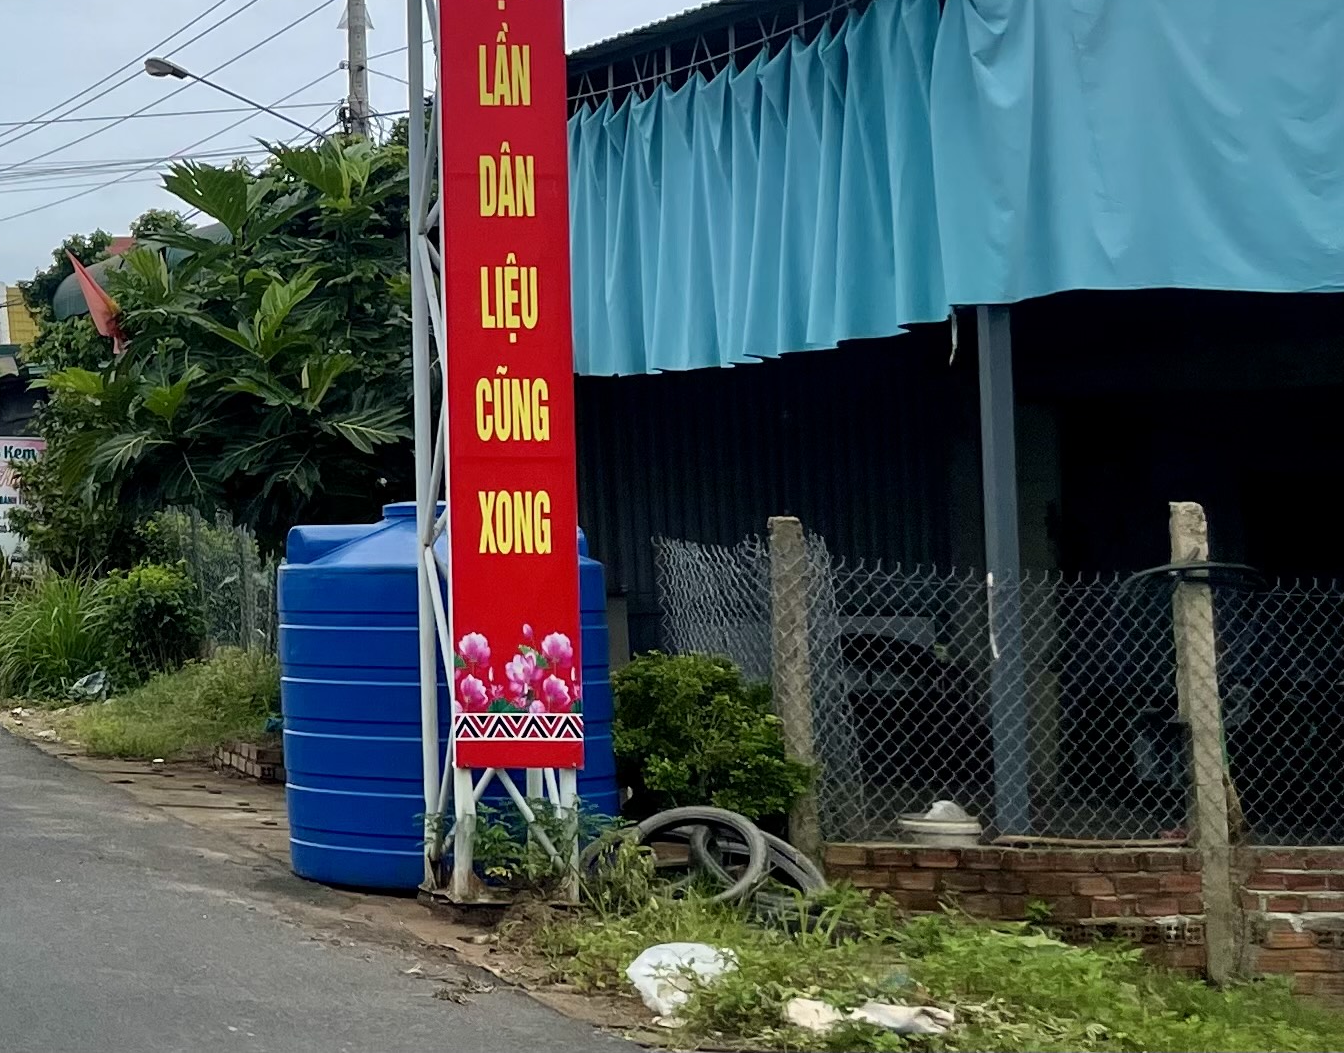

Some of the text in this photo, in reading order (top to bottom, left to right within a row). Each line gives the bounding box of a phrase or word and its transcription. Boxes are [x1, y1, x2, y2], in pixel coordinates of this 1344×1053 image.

[478, 24, 531, 106] LẦN
[479, 141, 535, 217] DÂN
[480, 252, 538, 343] LIỆU
[475, 365, 550, 442] CŨNG
[4, 445, 38, 462] Kem
[478, 489, 552, 555] XONG
